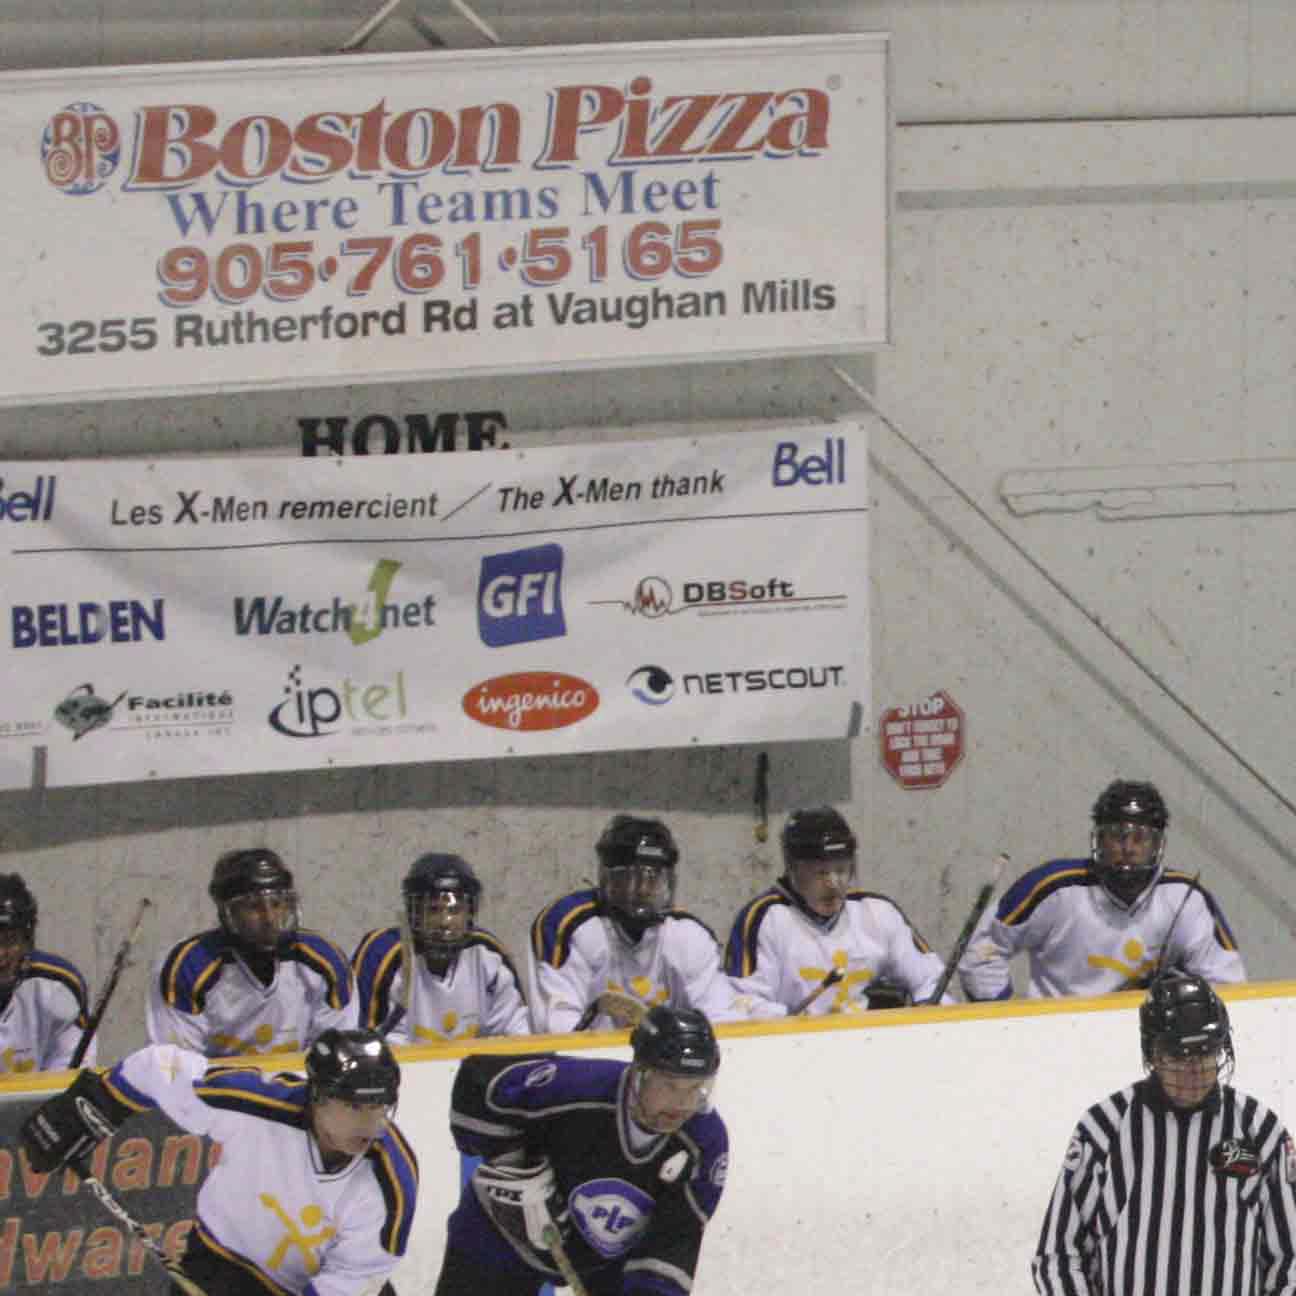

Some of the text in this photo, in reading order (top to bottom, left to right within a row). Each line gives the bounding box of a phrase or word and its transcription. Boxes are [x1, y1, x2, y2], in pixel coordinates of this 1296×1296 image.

[121, 75, 832, 192] Boston Pizza
[165, 168, 721, 239] Where Teams Meet
[36, 278, 837, 357] 3255 Rutherford Rd at Vaughan Mills
[298, 411, 511, 457] HOME
[772, 439, 846, 488] Bell
[0, 475, 56, 522] ell
[110, 490, 440, 526] Les X-Men remercient
[498, 469, 725, 513] The X-Men thank
[482, 571, 556, 618] GFI
[683, 578, 794, 603] DBSoft
[11, 598, 166, 648] BELDEN
[126, 690, 233, 711] Facilité
[477, 681, 584, 727] ingenico
